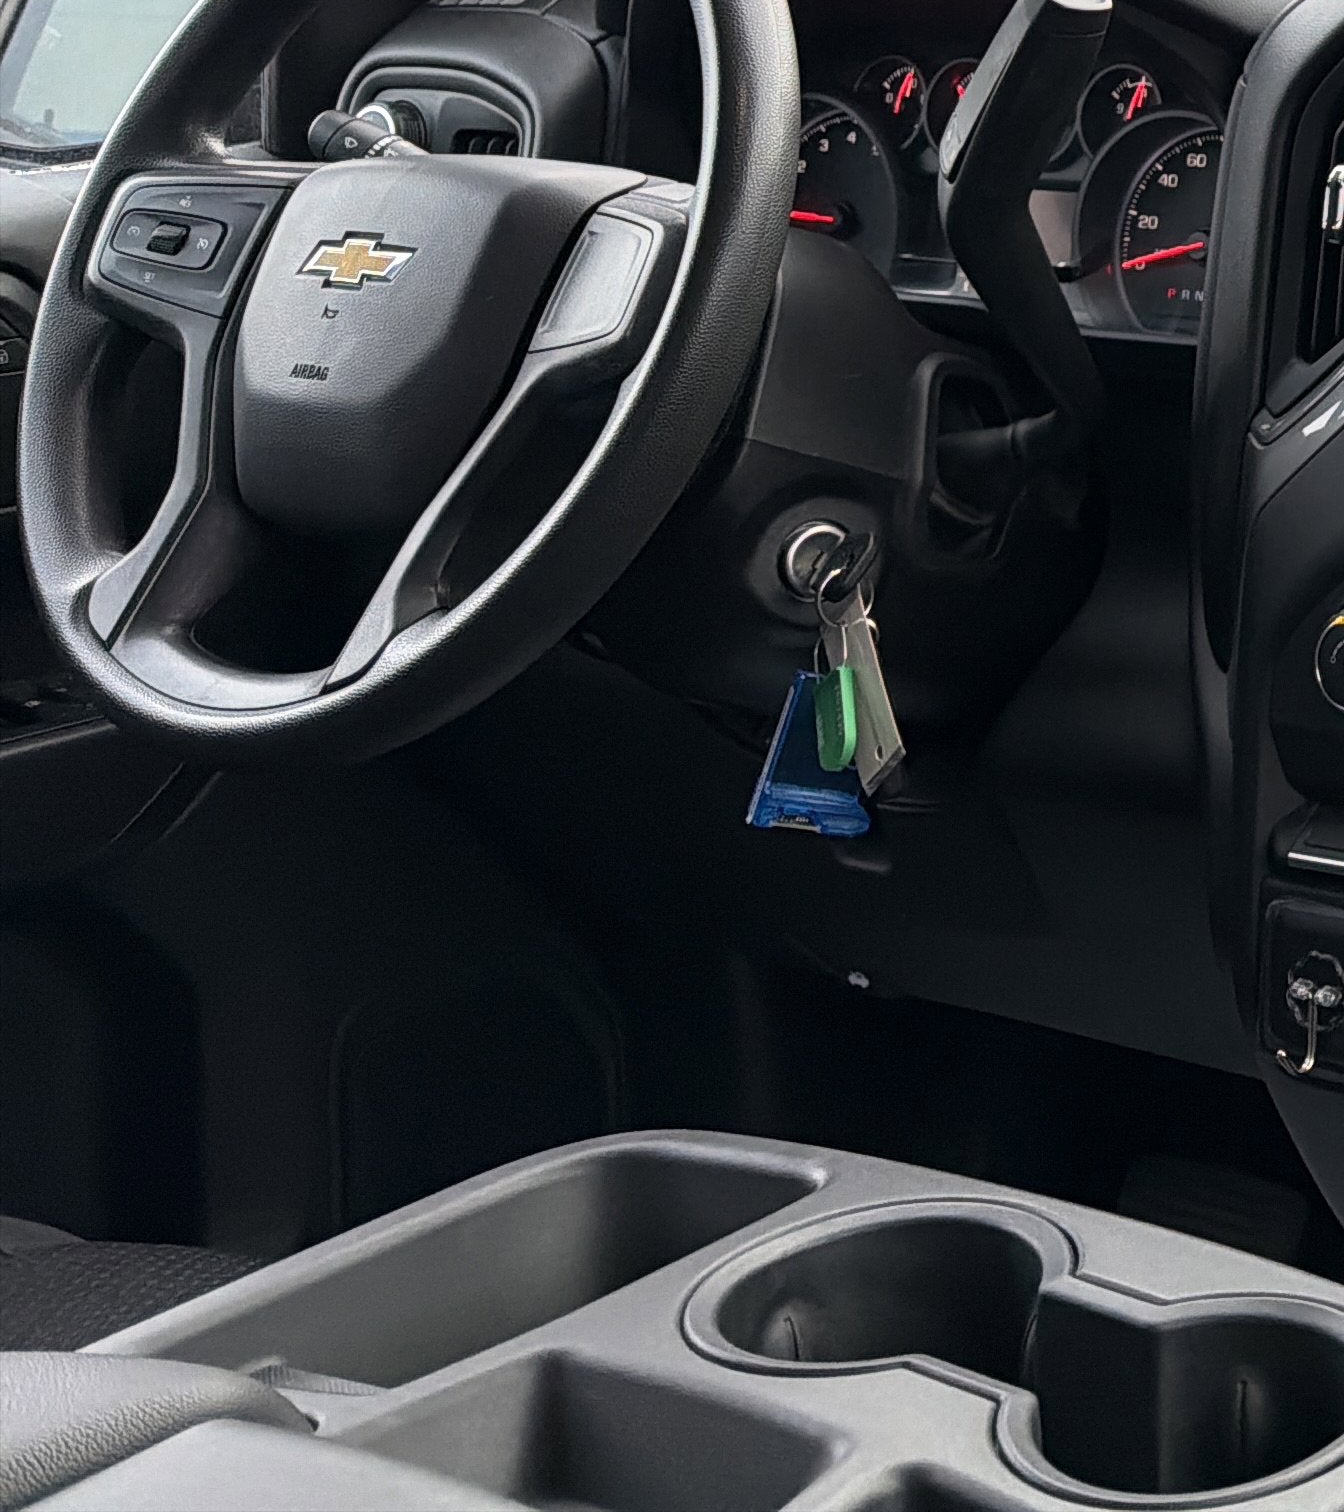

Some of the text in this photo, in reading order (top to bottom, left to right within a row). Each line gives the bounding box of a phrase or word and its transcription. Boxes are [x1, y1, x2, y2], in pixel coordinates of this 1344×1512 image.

[818, 138, 829, 153] 3
[1186, 153, 1207, 168] 60
[1157, 173, 1179, 188] 40
[1138, 215, 1159, 230] 20
[1168, 288, 1204, 302] P R N
[289, 363, 330, 382] AIRBAG
